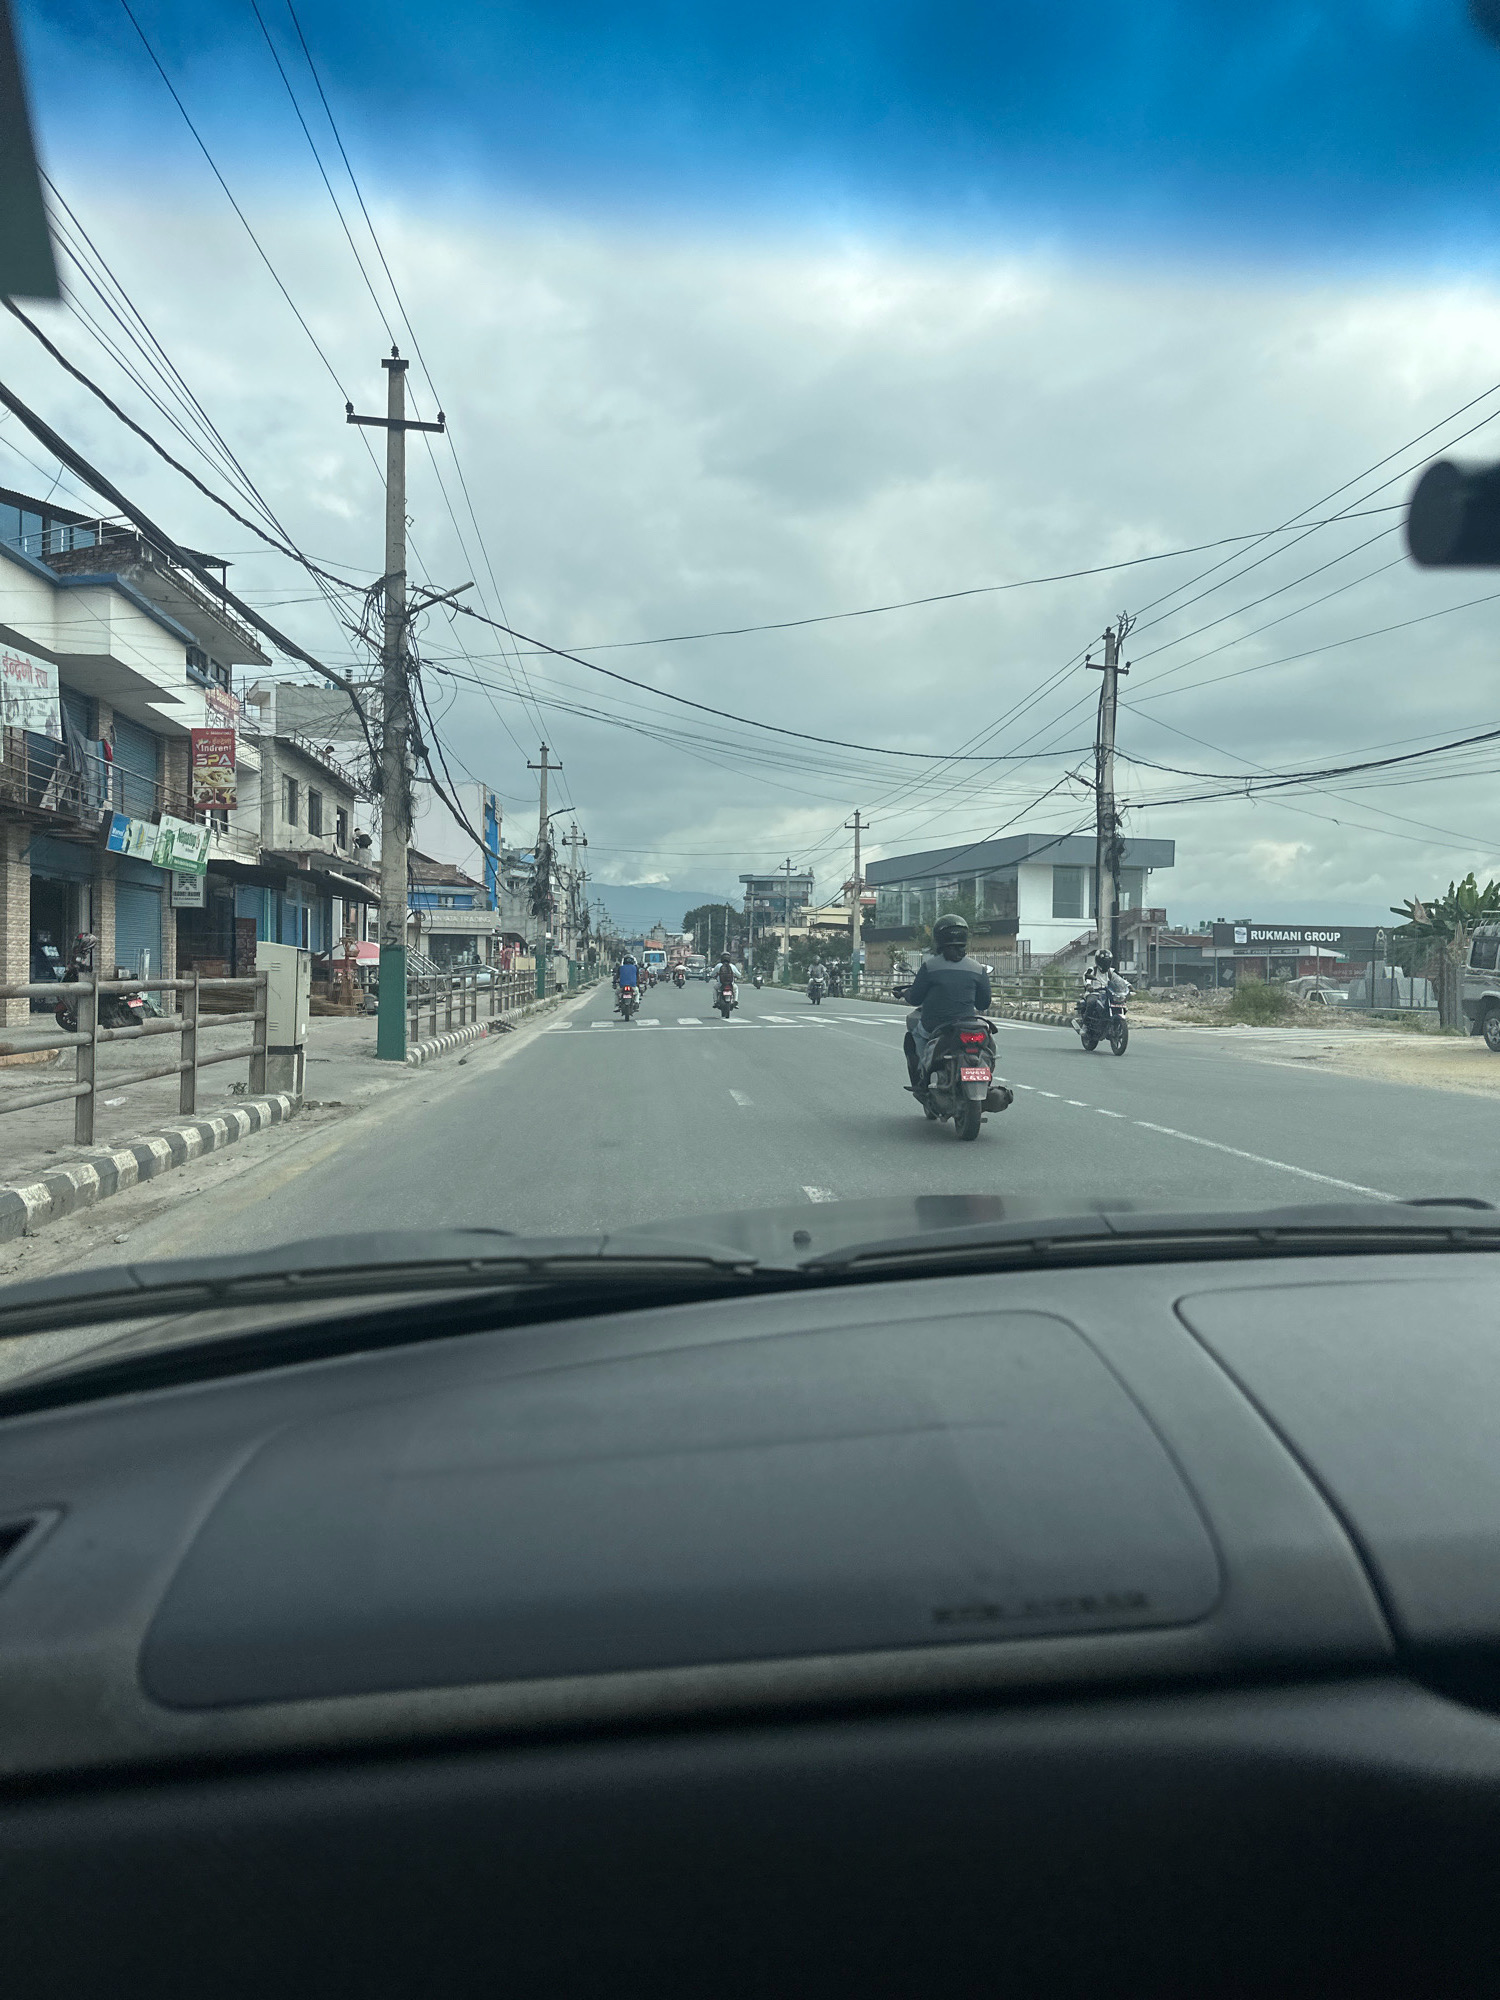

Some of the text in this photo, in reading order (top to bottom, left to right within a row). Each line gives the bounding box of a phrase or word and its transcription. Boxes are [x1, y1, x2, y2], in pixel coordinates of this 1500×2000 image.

[201, 744, 232, 752] Indreni
[196, 754, 232, 765] SPA
[460, 915, 491, 923] TRADING
[1251, 931, 1341, 942] RUKMANI GROUP
